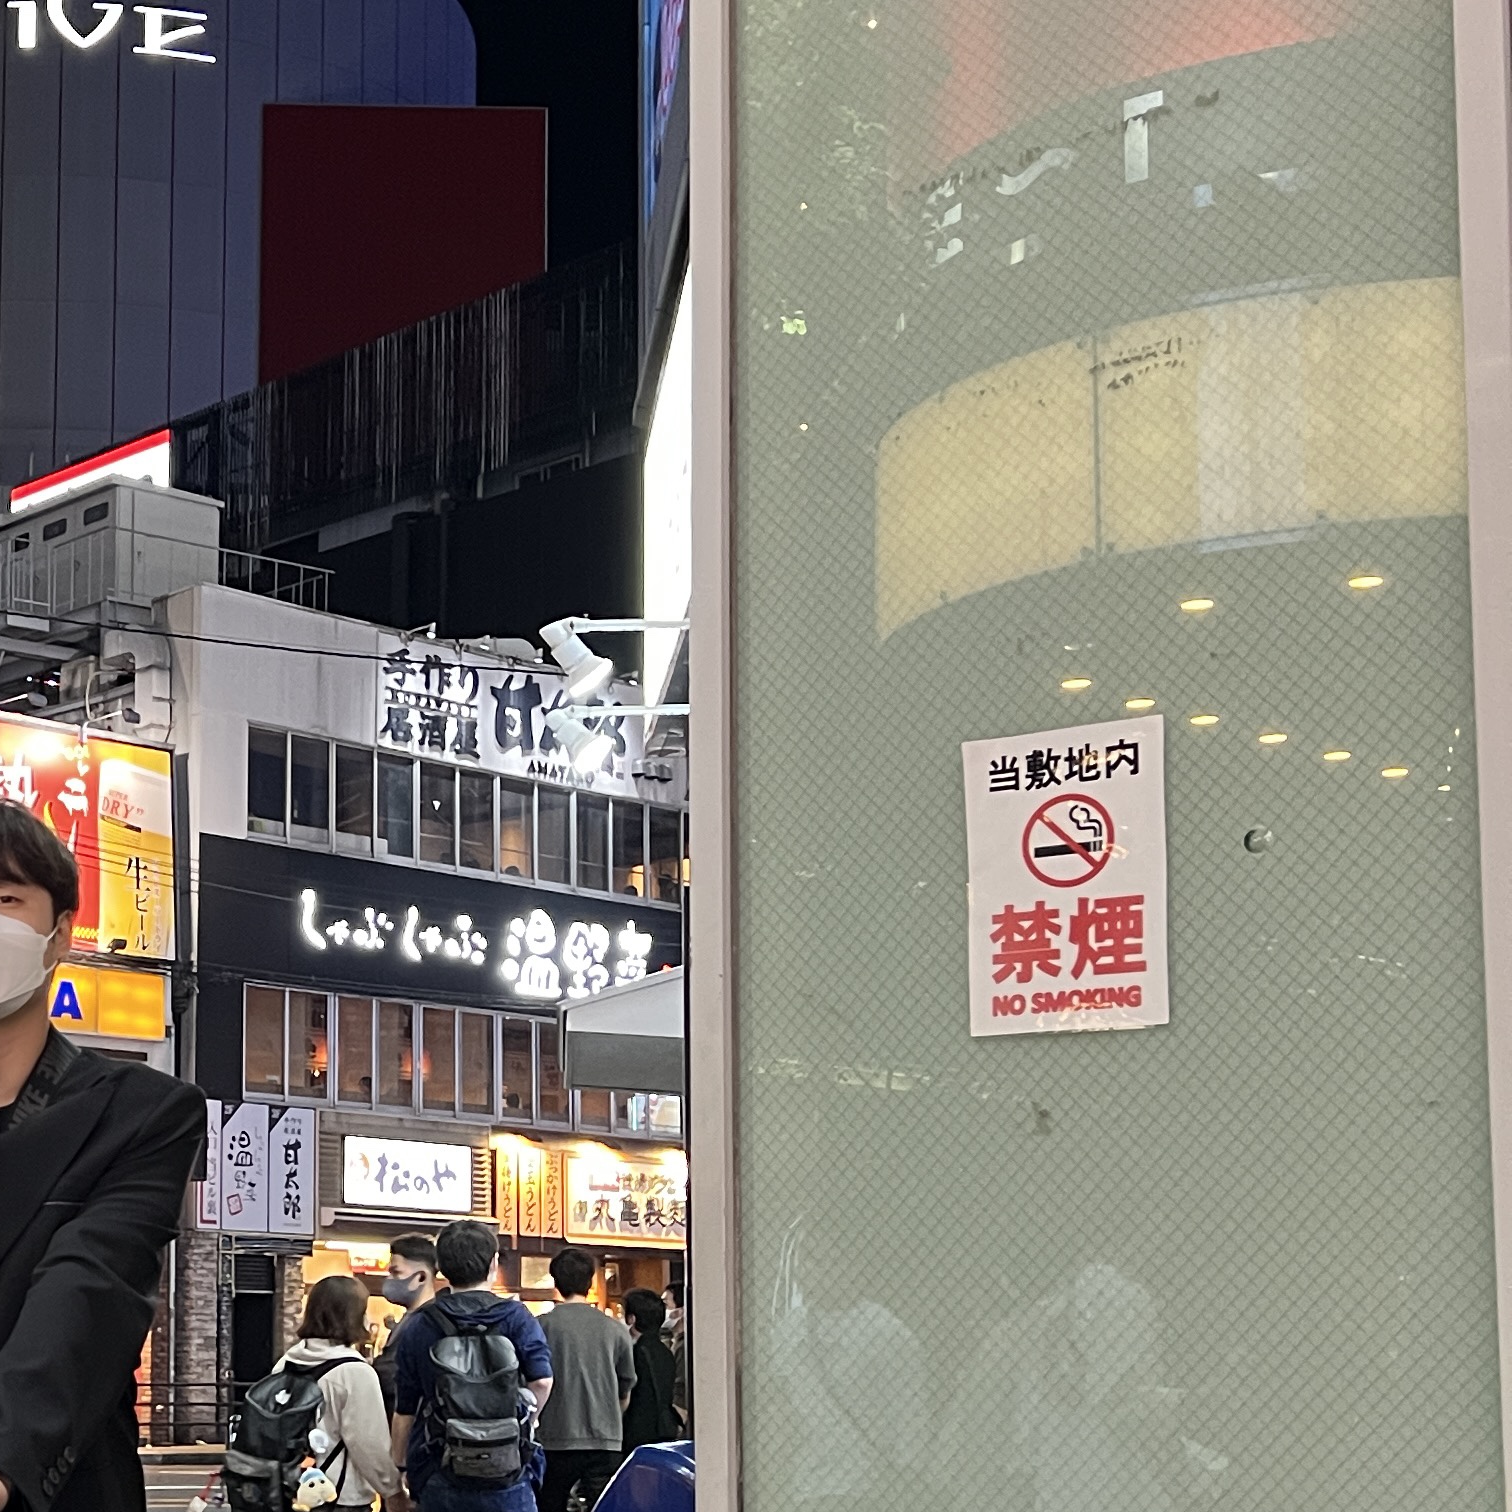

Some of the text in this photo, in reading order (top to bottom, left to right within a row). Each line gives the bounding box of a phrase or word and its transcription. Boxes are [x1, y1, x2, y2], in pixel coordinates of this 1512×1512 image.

[382, 648, 480, 703] 手作り
[987, 738, 1140, 792] 当敷地内
[125, 856, 152, 951] 生ビール
[300, 887, 489, 966] しゃぶしゃぶ
[989, 893, 1148, 984] 禁煙
[992, 985, 1143, 1017] NO SMOKING
[282, 1137, 302, 1220] 甘太郎
[374, 1152, 457, 1195] 松のや
